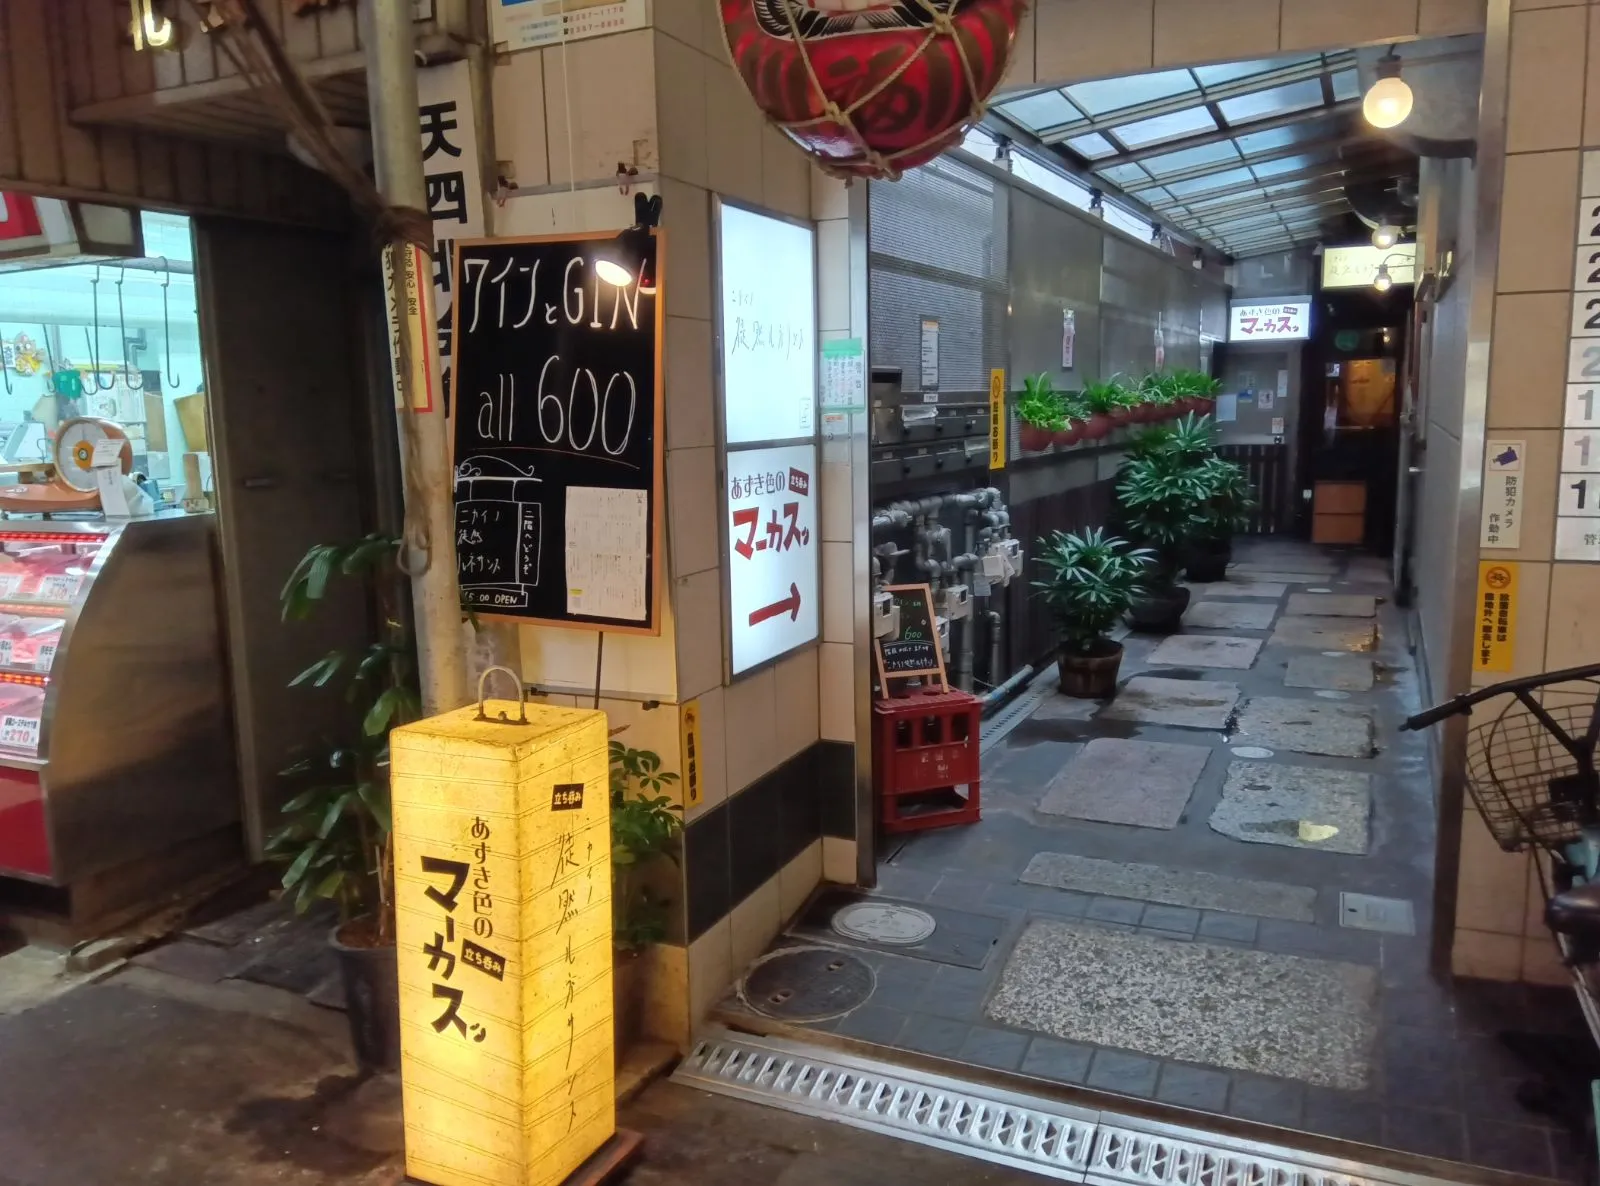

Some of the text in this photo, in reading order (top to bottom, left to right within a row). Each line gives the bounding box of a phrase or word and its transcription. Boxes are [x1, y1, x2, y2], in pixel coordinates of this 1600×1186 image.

[1581, 345, 1600, 377] 2
[478, 355, 636, 455] all 600
[1577, 389, 1594, 421] 1
[1574, 435, 1591, 466] 1
[1504, 475, 1518, 529] 防犯カメラ
[523, 510, 535, 575] 二階へどうぞ
[1487, 512, 1501, 544] 作動中
[494, 594, 518, 604] OPEN
[904, 625, 922, 640] 600
[553, 791, 582, 805] 立ち呑み
[463, 948, 502, 974] 立ち呑み
